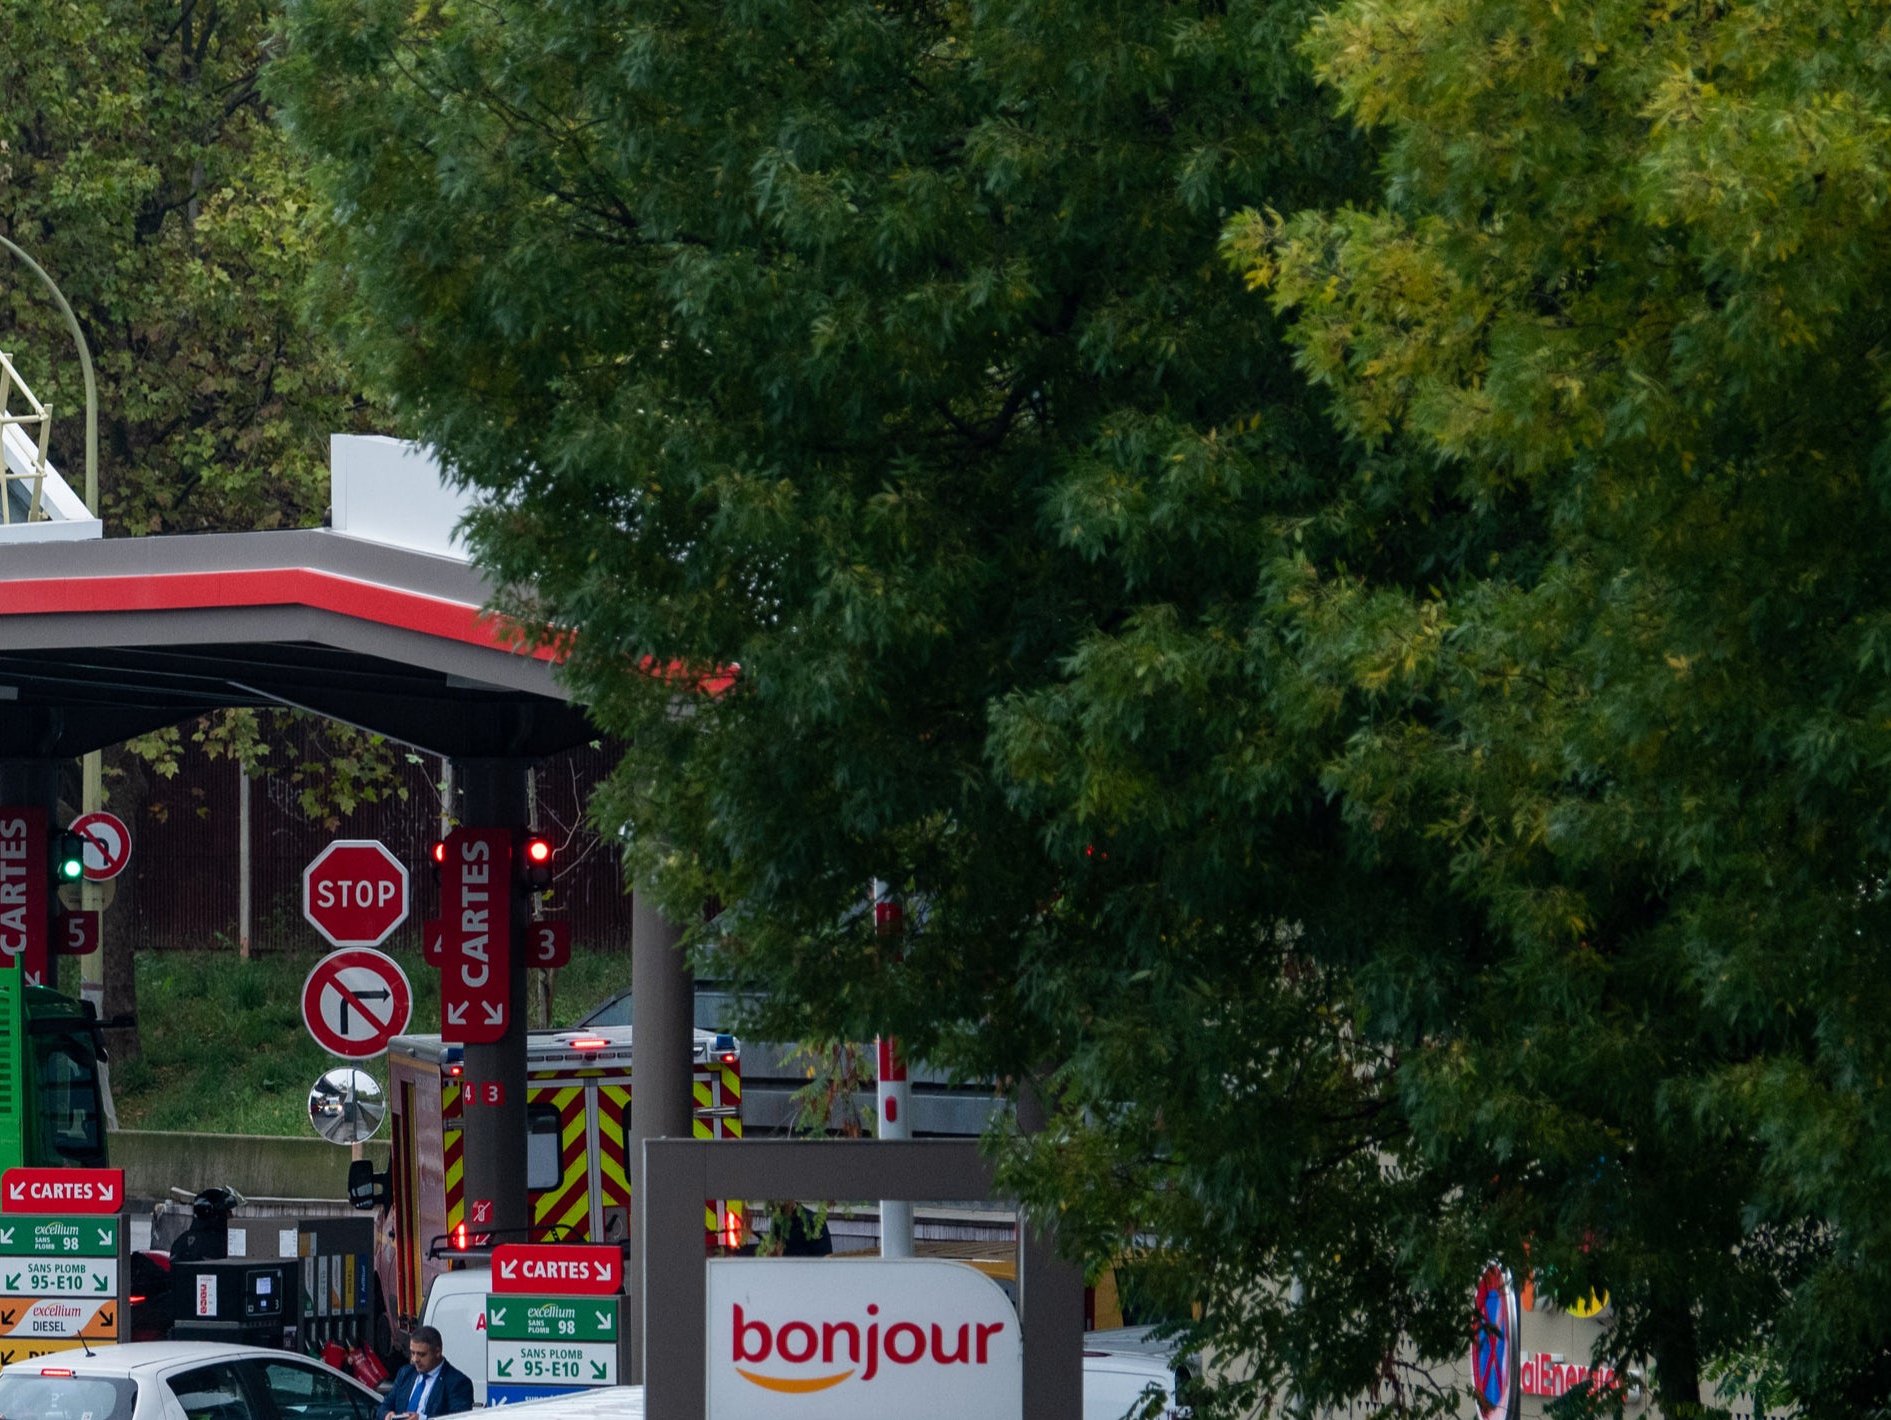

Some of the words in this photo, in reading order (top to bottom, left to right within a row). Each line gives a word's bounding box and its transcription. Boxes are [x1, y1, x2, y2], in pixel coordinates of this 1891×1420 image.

[0, 817, 28, 956] CARTES
[317, 880, 396, 909] STOP
[461, 839, 489, 988] CARTES
[68, 918, 86, 948] 5
[538, 929, 557, 961] 3
[464, 1085, 472, 1100] 4
[488, 1085, 499, 1102] 3
[30, 1183, 93, 1199] CARTES
[35, 1223, 79, 1235] excellium
[63, 1237, 79, 1250] 98
[28, 1263, 51, 1273] SANS
[55, 1264, 86, 1274] PLOMB
[522, 1261, 590, 1279] CARTES
[31, 1275, 83, 1290] 95-E10
[33, 1303, 81, 1317] excellium
[528, 1304, 575, 1318] excellium
[33, 1321, 66, 1332] DIESEL
[558, 1320, 575, 1334] 98
[732, 1303, 1005, 1381] bonjour
[521, 1348, 546, 1359] SANS
[550, 1349, 583, 1359] PLOMB
[524, 1361, 580, 1377] 95-E10
